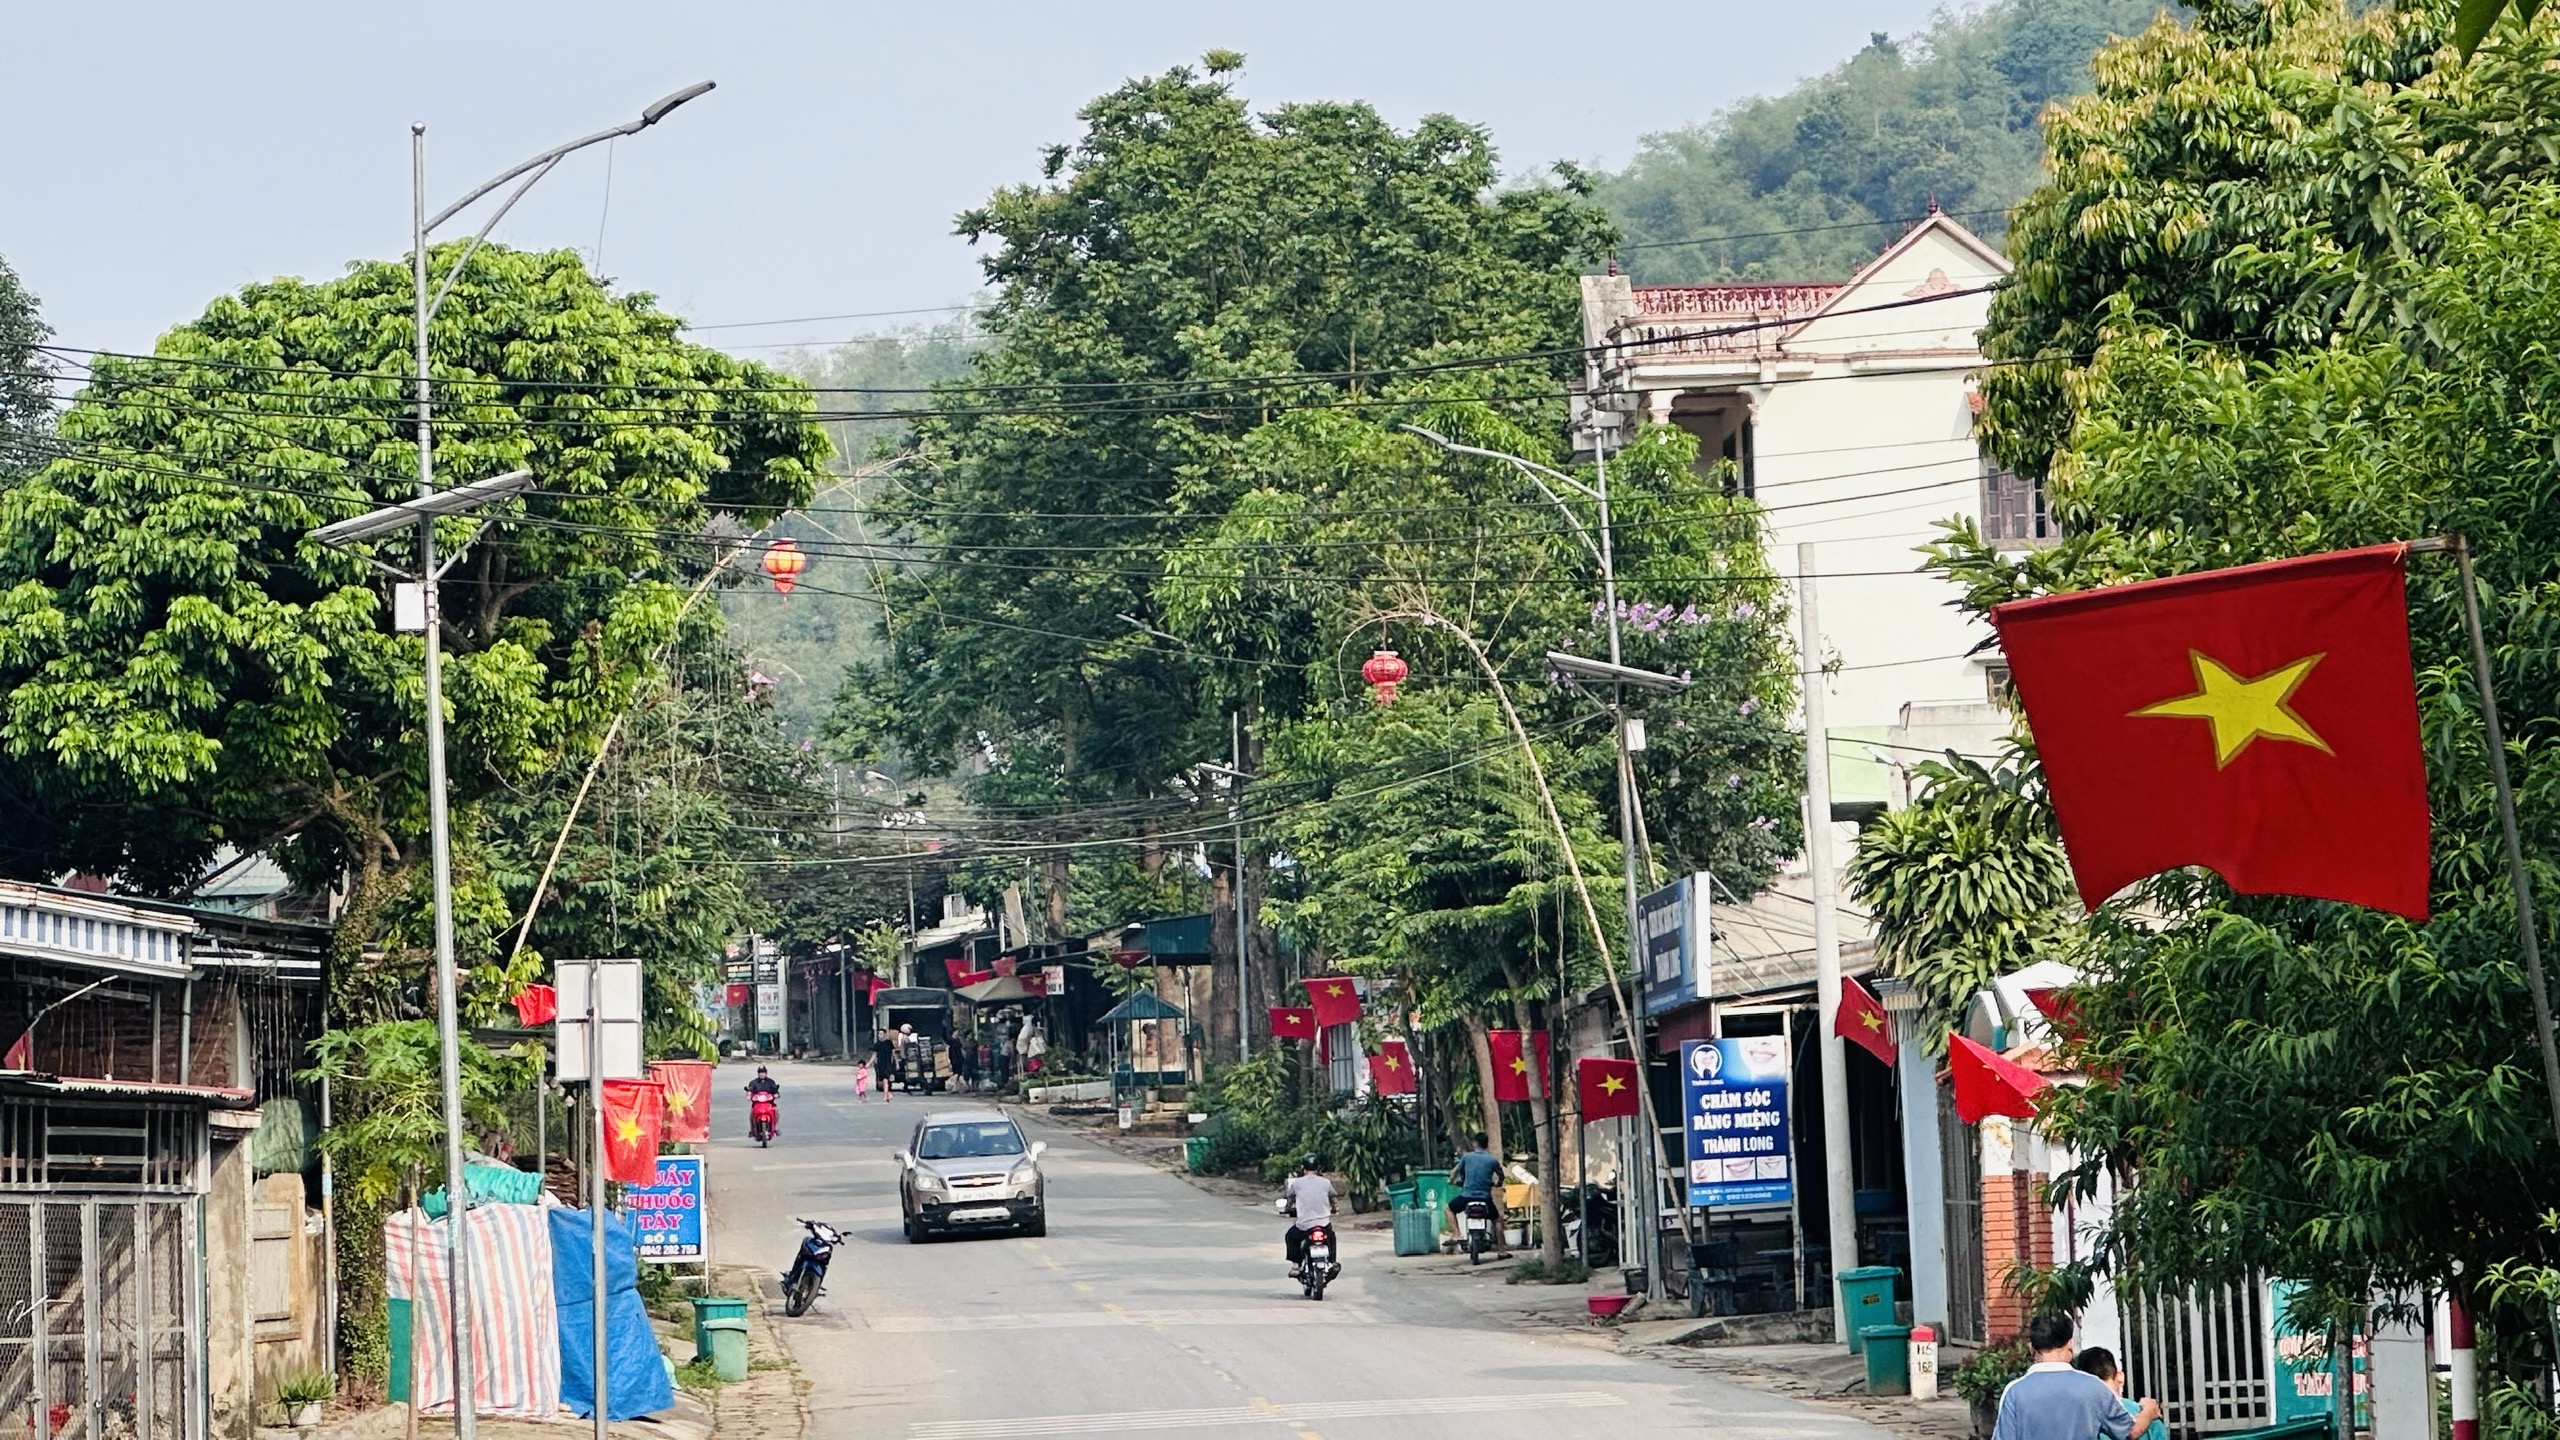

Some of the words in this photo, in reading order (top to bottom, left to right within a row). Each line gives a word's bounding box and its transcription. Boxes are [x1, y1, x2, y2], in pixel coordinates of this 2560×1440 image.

[1701, 1090, 1742, 1109] CHĂM
[1744, 1088, 1771, 1107] SÓC
[1693, 1112, 1732, 1130] RĂNG
[1734, 1109, 1780, 1131] MIỆNG
[1702, 1135, 1741, 1154] THÀNH
[1743, 1136, 1774, 1152] LONG
[625, 1188, 695, 1210] THUỐC
[638, 1211, 683, 1231] TÂY
[644, 1231, 665, 1243] SỐ
[640, 1245, 661, 1255] 0942
